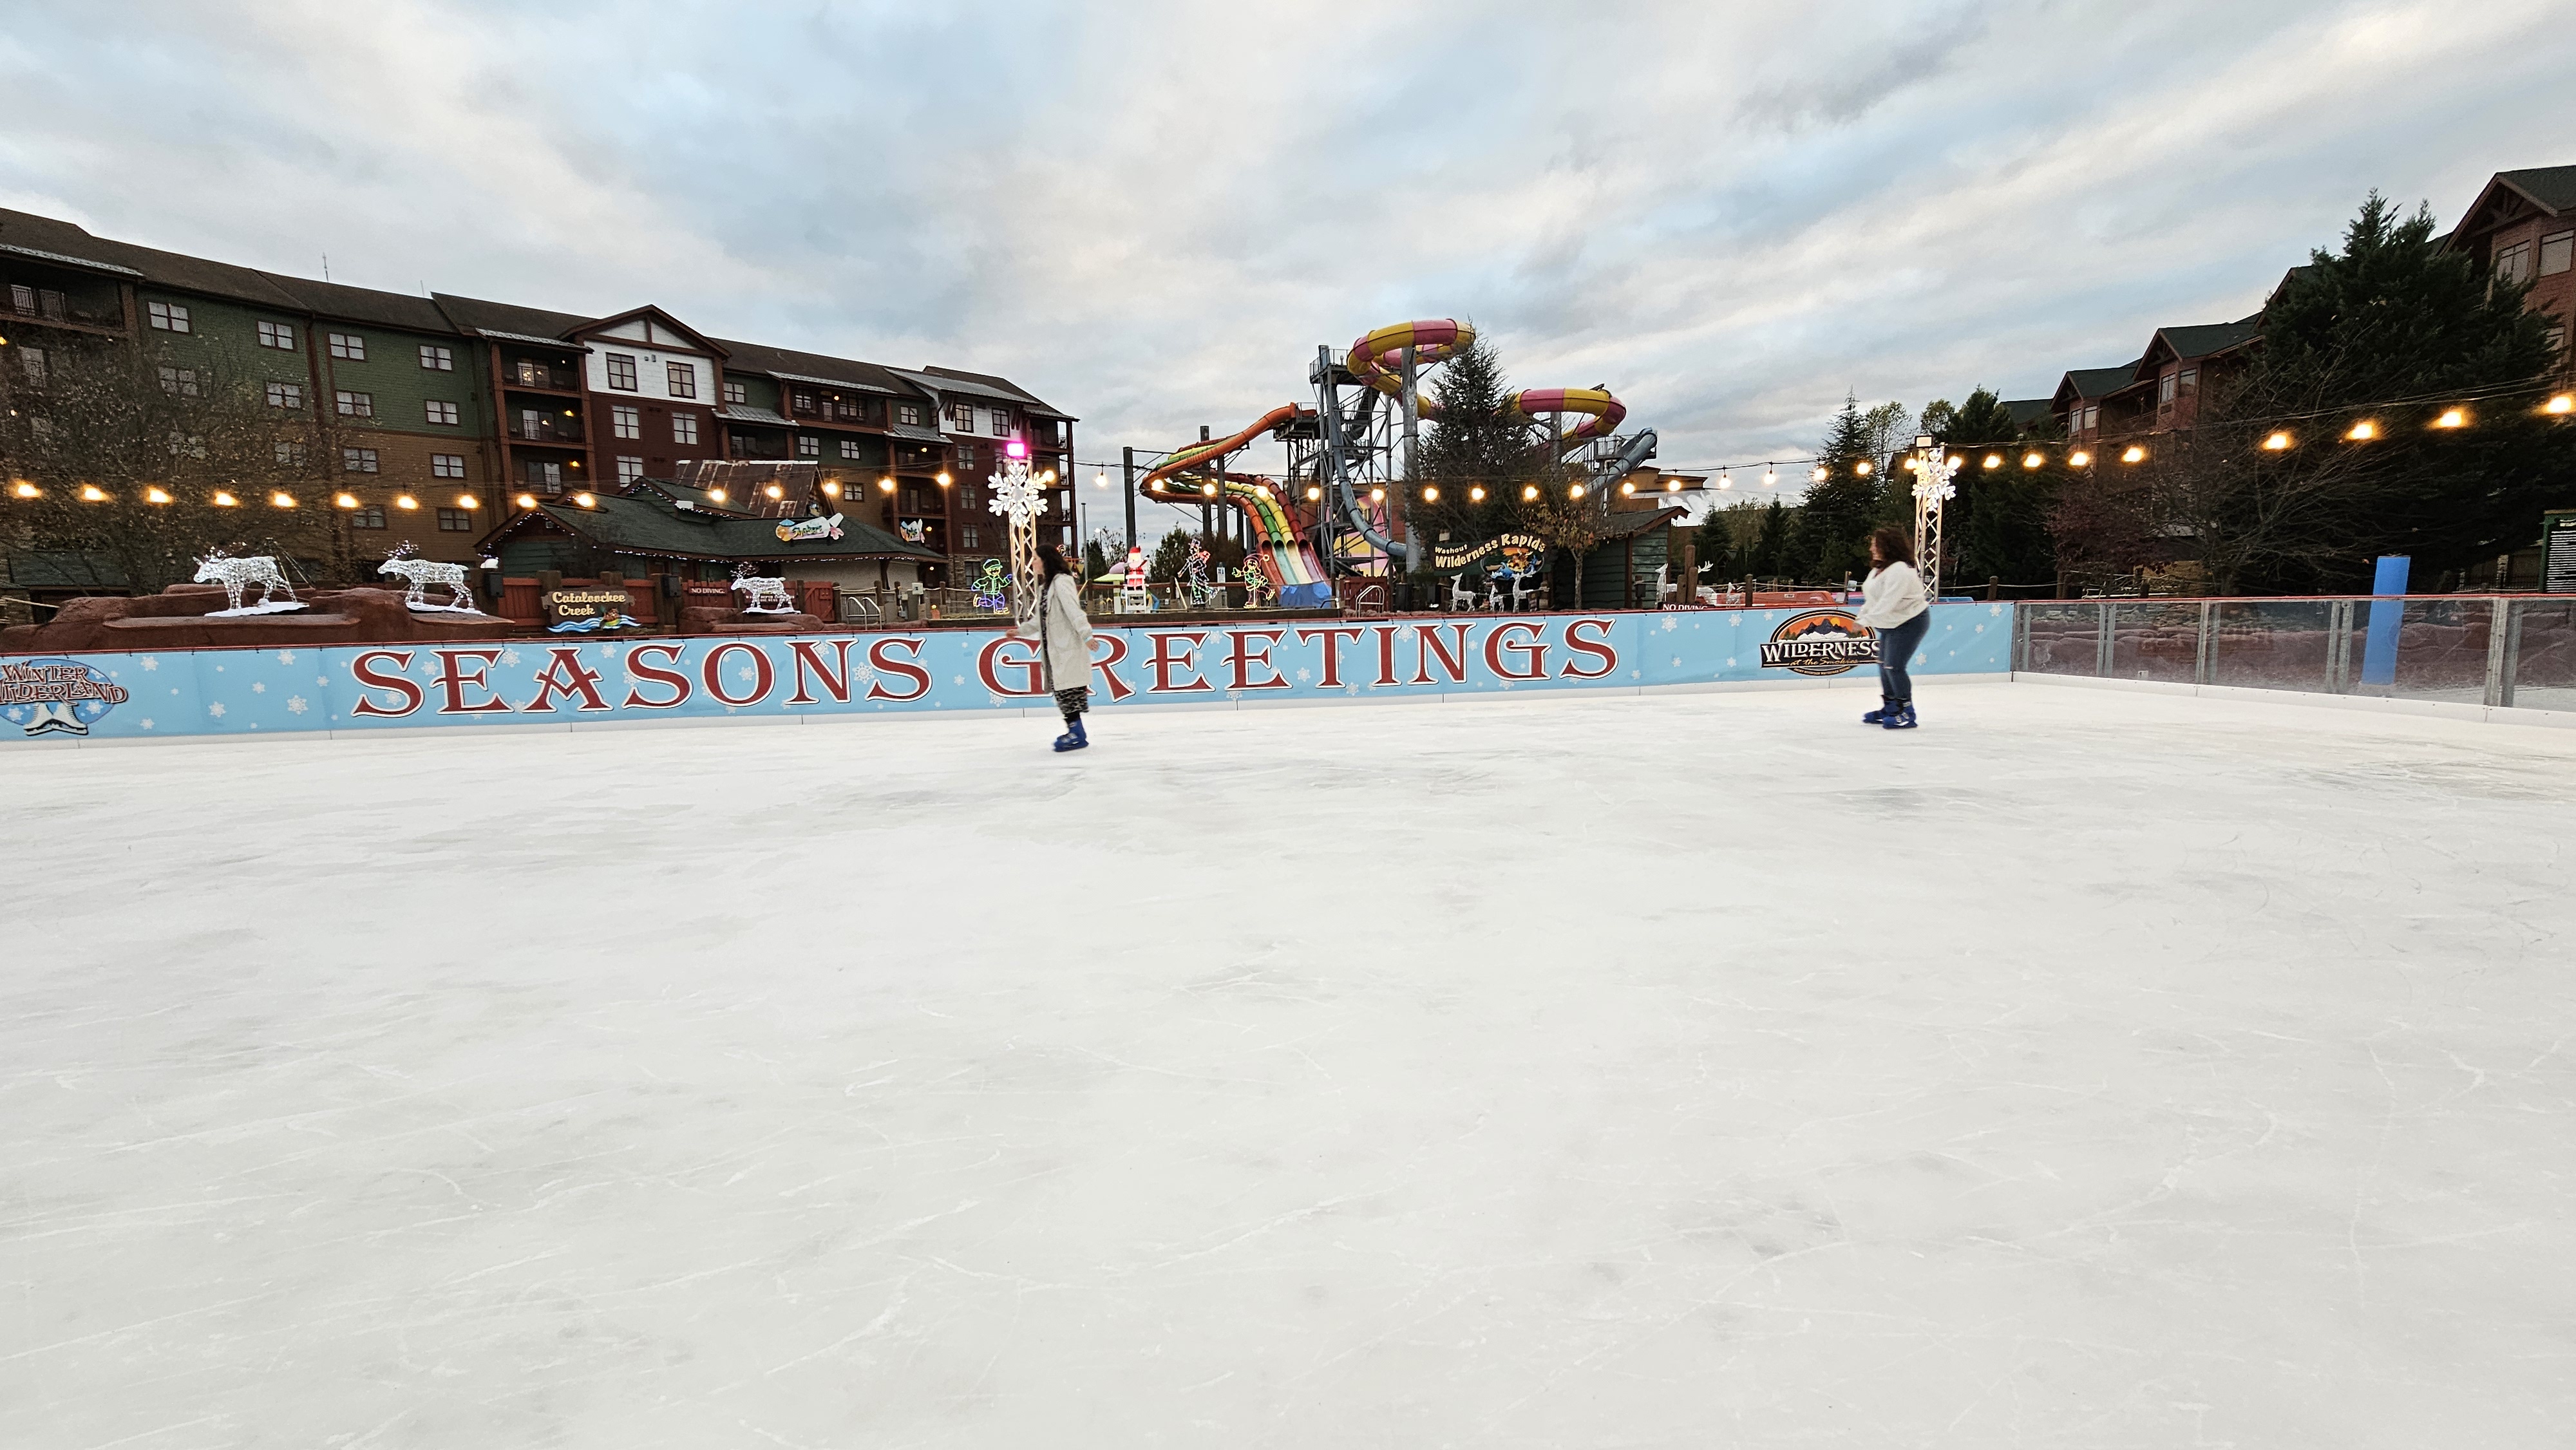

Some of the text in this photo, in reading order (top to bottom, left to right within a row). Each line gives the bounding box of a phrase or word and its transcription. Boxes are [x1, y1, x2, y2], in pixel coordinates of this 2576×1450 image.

[1435, 544, 1468, 554] Washout
[1435, 533, 1546, 568] Wilderness Rapids
[552, 591, 626, 603] Cataloochee
[558, 605, 596, 616] Creek
[2, 659, 91, 684] WINTER
[350, 618, 1620, 717] SEASONS GREETINGS
[0, 679, 129, 706] ILDERLAND
